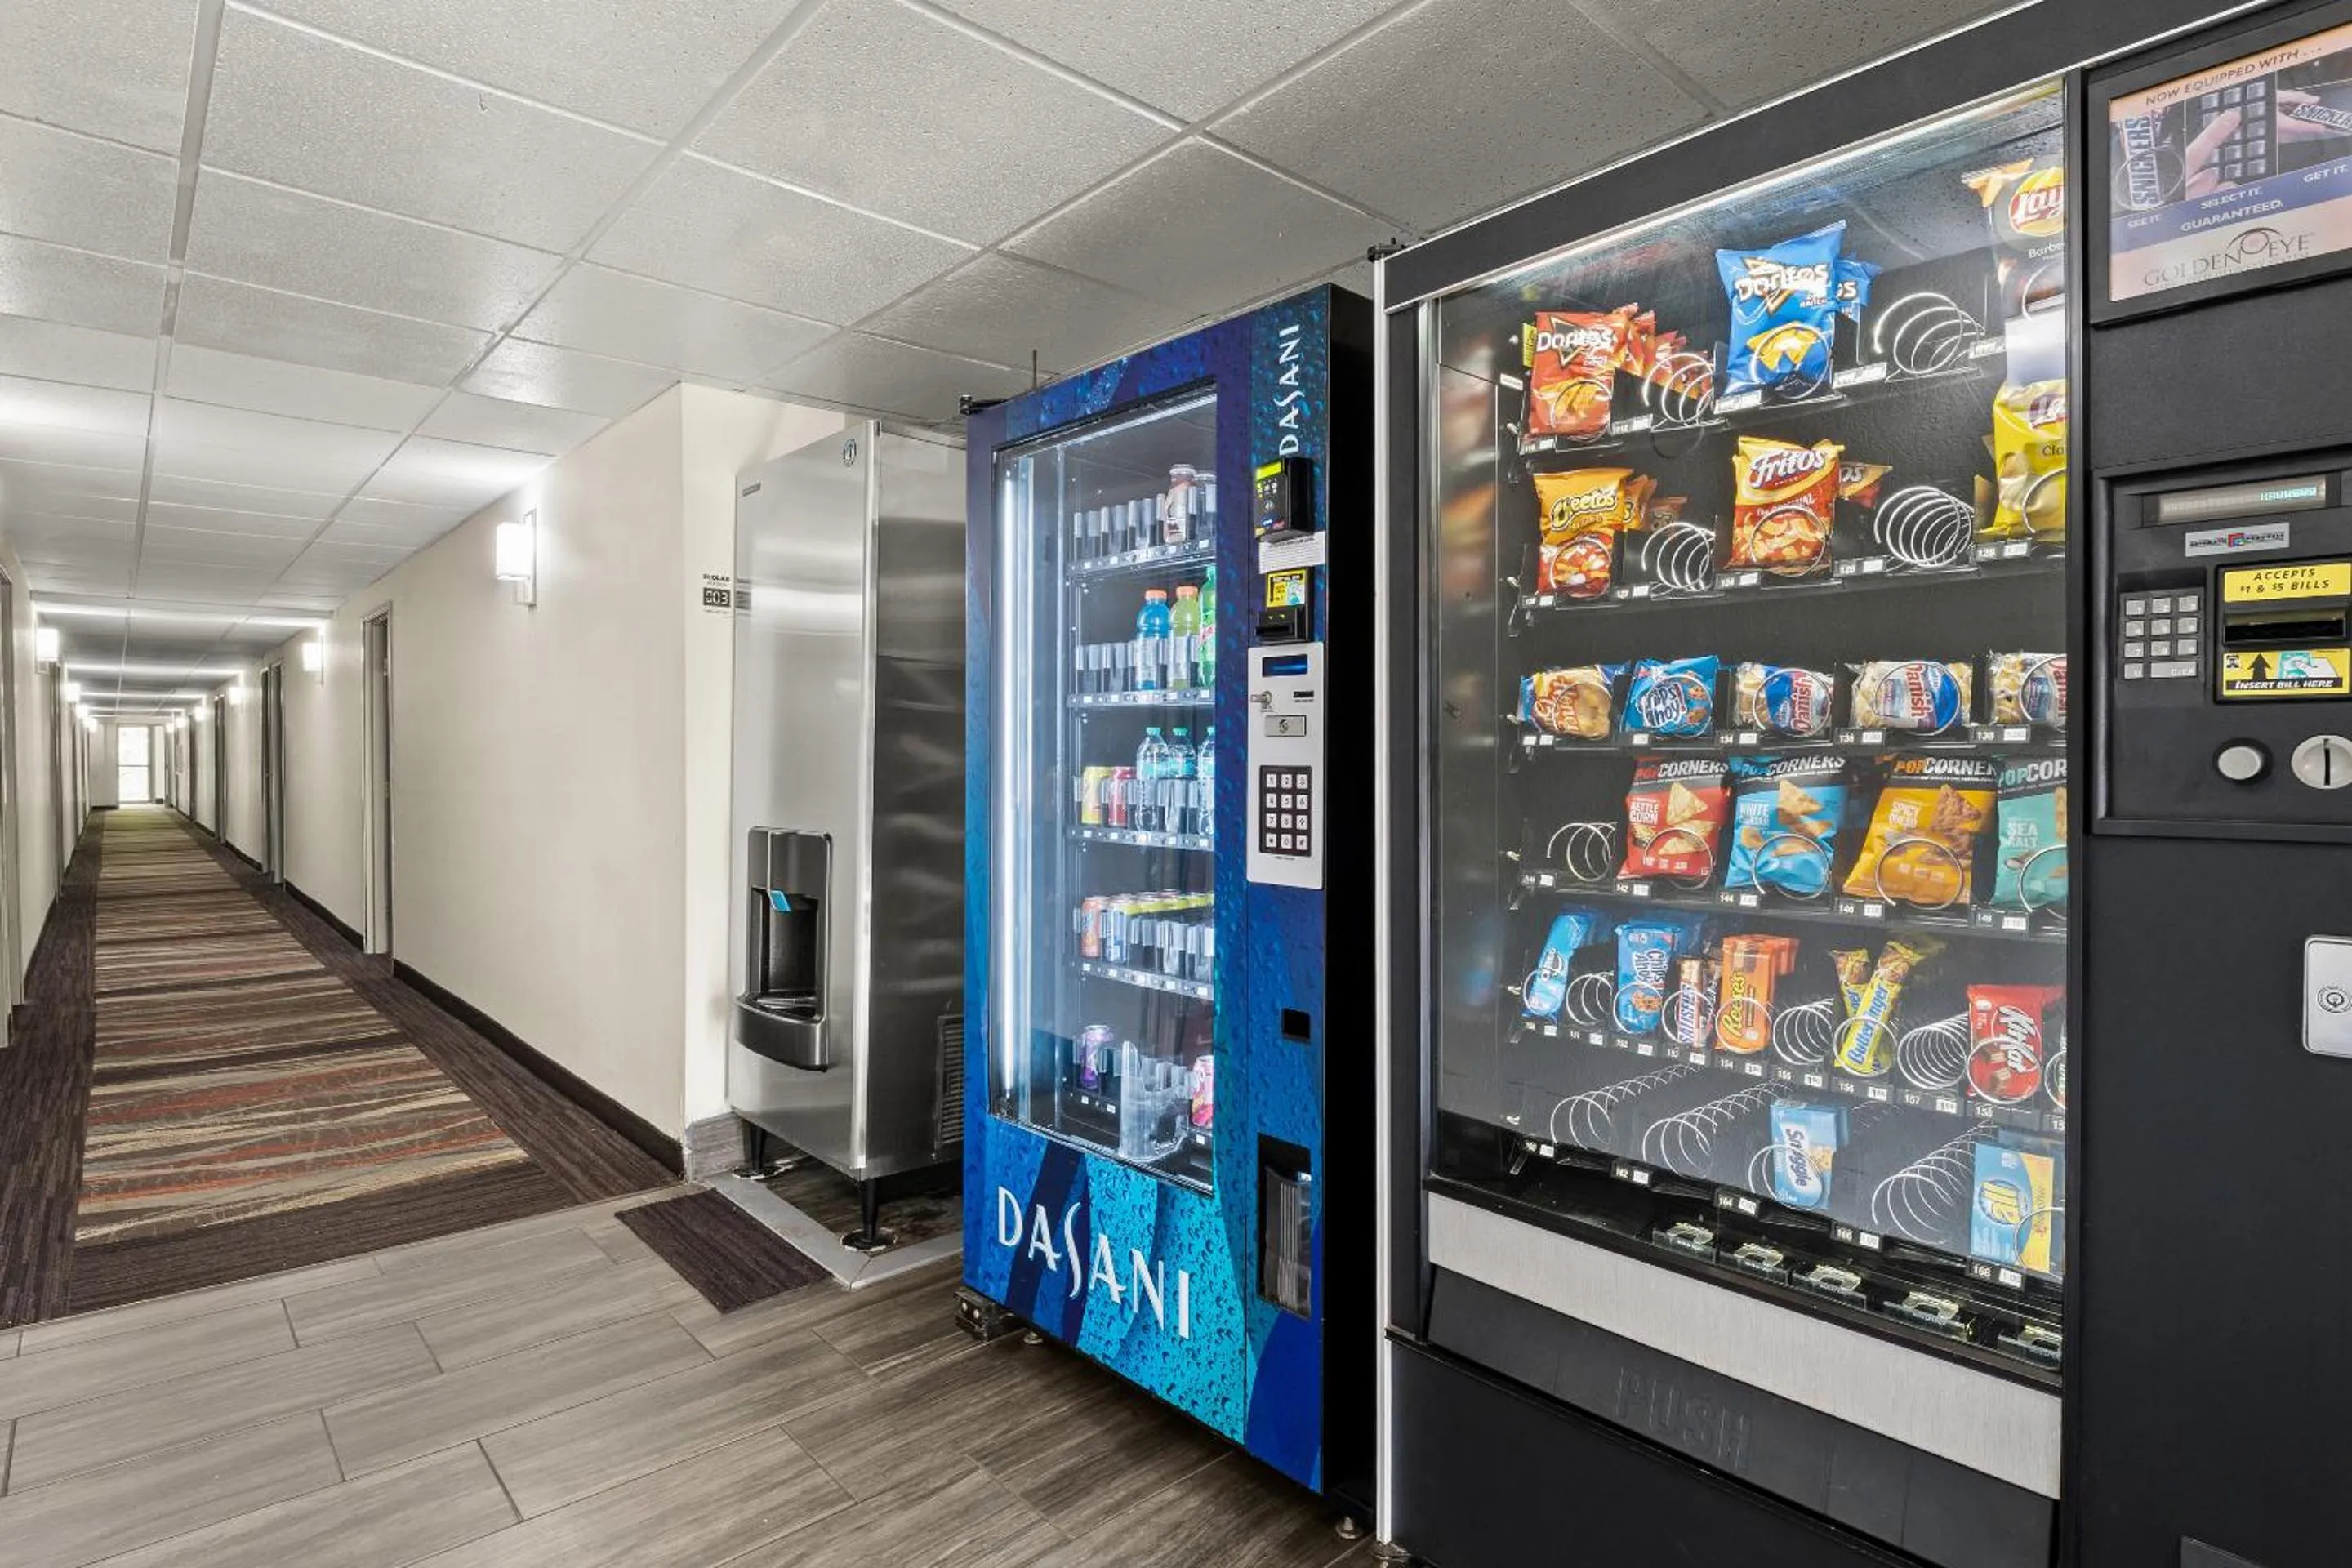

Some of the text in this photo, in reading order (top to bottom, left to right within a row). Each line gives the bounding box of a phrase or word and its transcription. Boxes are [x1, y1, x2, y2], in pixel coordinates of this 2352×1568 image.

[2145, 88, 2180, 105] NOW
[2185, 64, 2255, 93] EQUIPPED
[2125, 116, 2162, 206] SNICKERS
[2303, 171, 2330, 183] GET
[2200, 190, 2242, 209] SELECT
[2127, 218, 2148, 229] SEE
[2029, 242, 2064, 258] Barbe
[1274, 324, 1304, 456] DASANI
[1751, 449, 1828, 488] Fritos
[1552, 488, 1617, 529] Cheetos
[2254, 568, 2316, 581] ACCEPTS
[2240, 586, 2251, 594] $1
[2272, 582, 2284, 591] $5
[2291, 581, 2330, 590] BILLS
[1906, 665, 1933, 719] Danish
[2235, 679, 2334, 690] INSERT BILL HERE
[1791, 675, 1813, 733] Danish
[1895, 757, 1997, 775] POPCORNE
[1630, 813, 1658, 824] CORN
[2008, 822, 2037, 836] SEA
[1722, 969, 1745, 1038] Reese's
[2052, 1120, 2065, 1131] 15
[1786, 1128, 1811, 1187] Snuggle
[998, 1186, 1190, 1339] DASANI
[1973, 1265, 1991, 1277] 168
